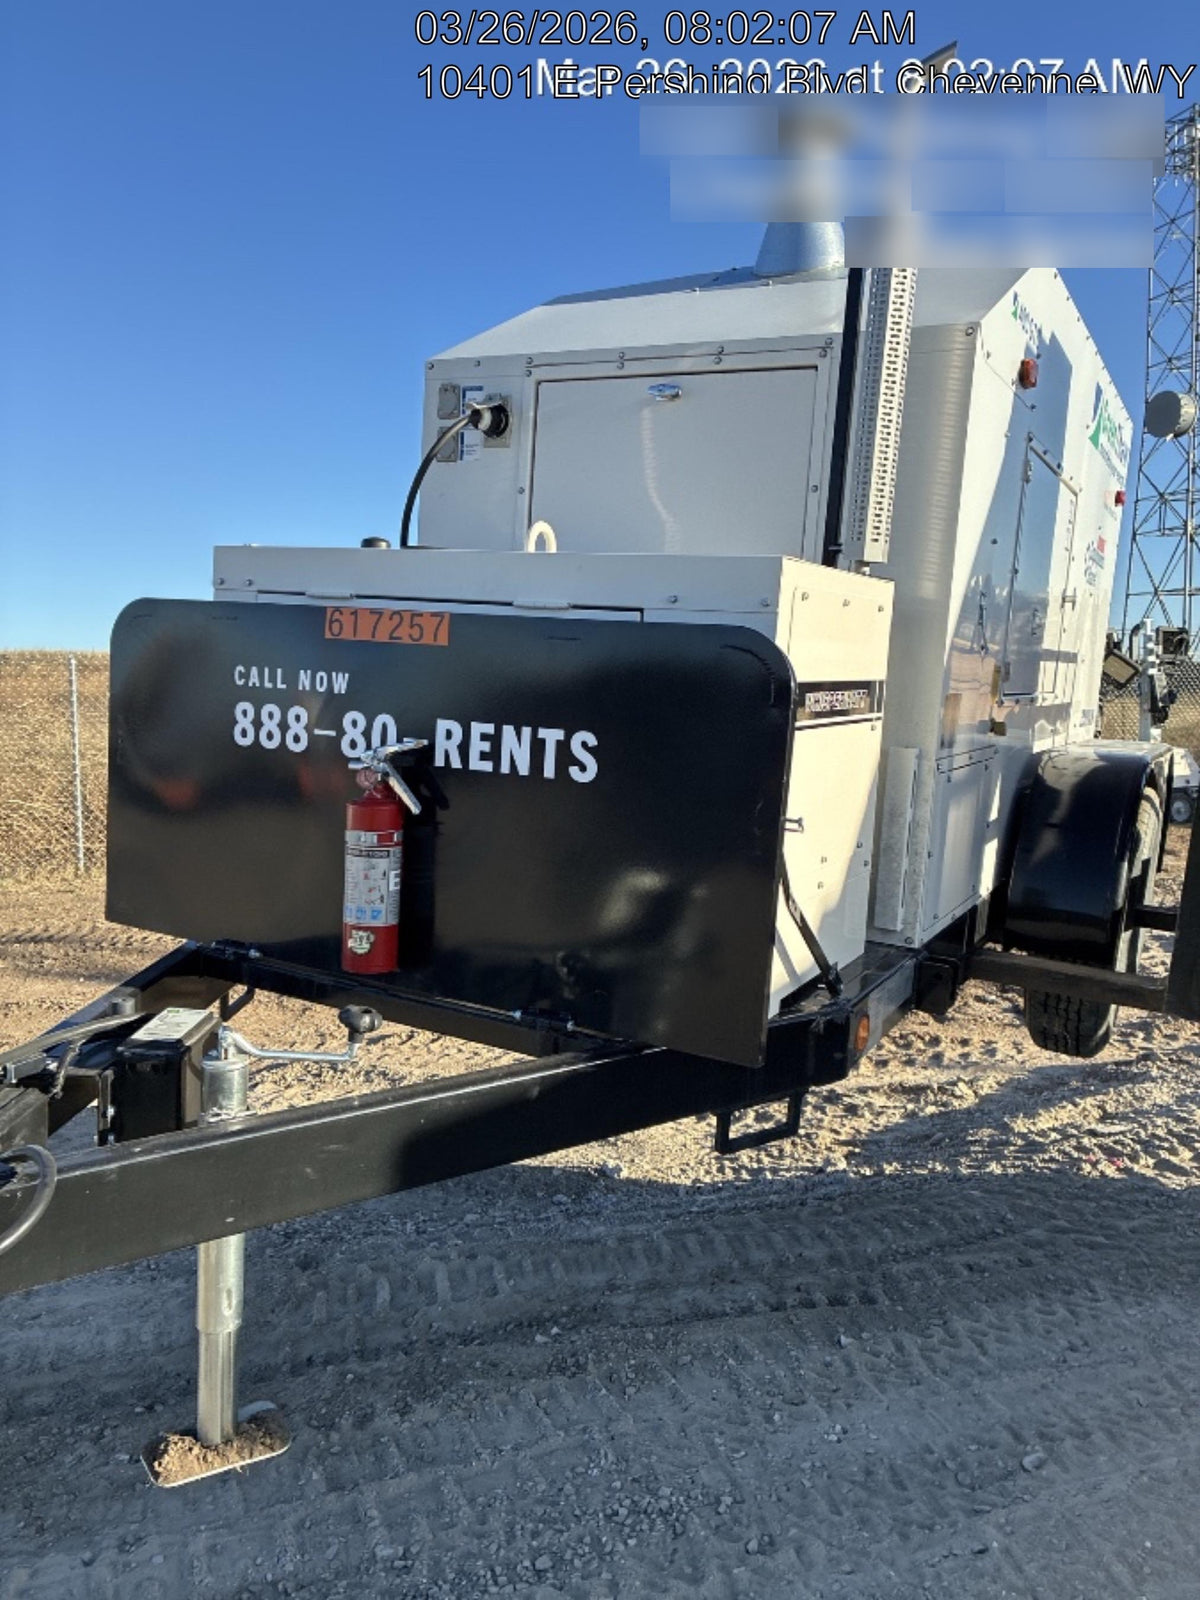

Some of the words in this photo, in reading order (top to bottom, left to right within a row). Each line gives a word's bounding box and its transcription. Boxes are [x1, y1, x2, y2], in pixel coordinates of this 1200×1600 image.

[326, 607, 446, 643] 617257
[233, 664, 287, 690] CALL
[297, 669, 350, 695] NOW
